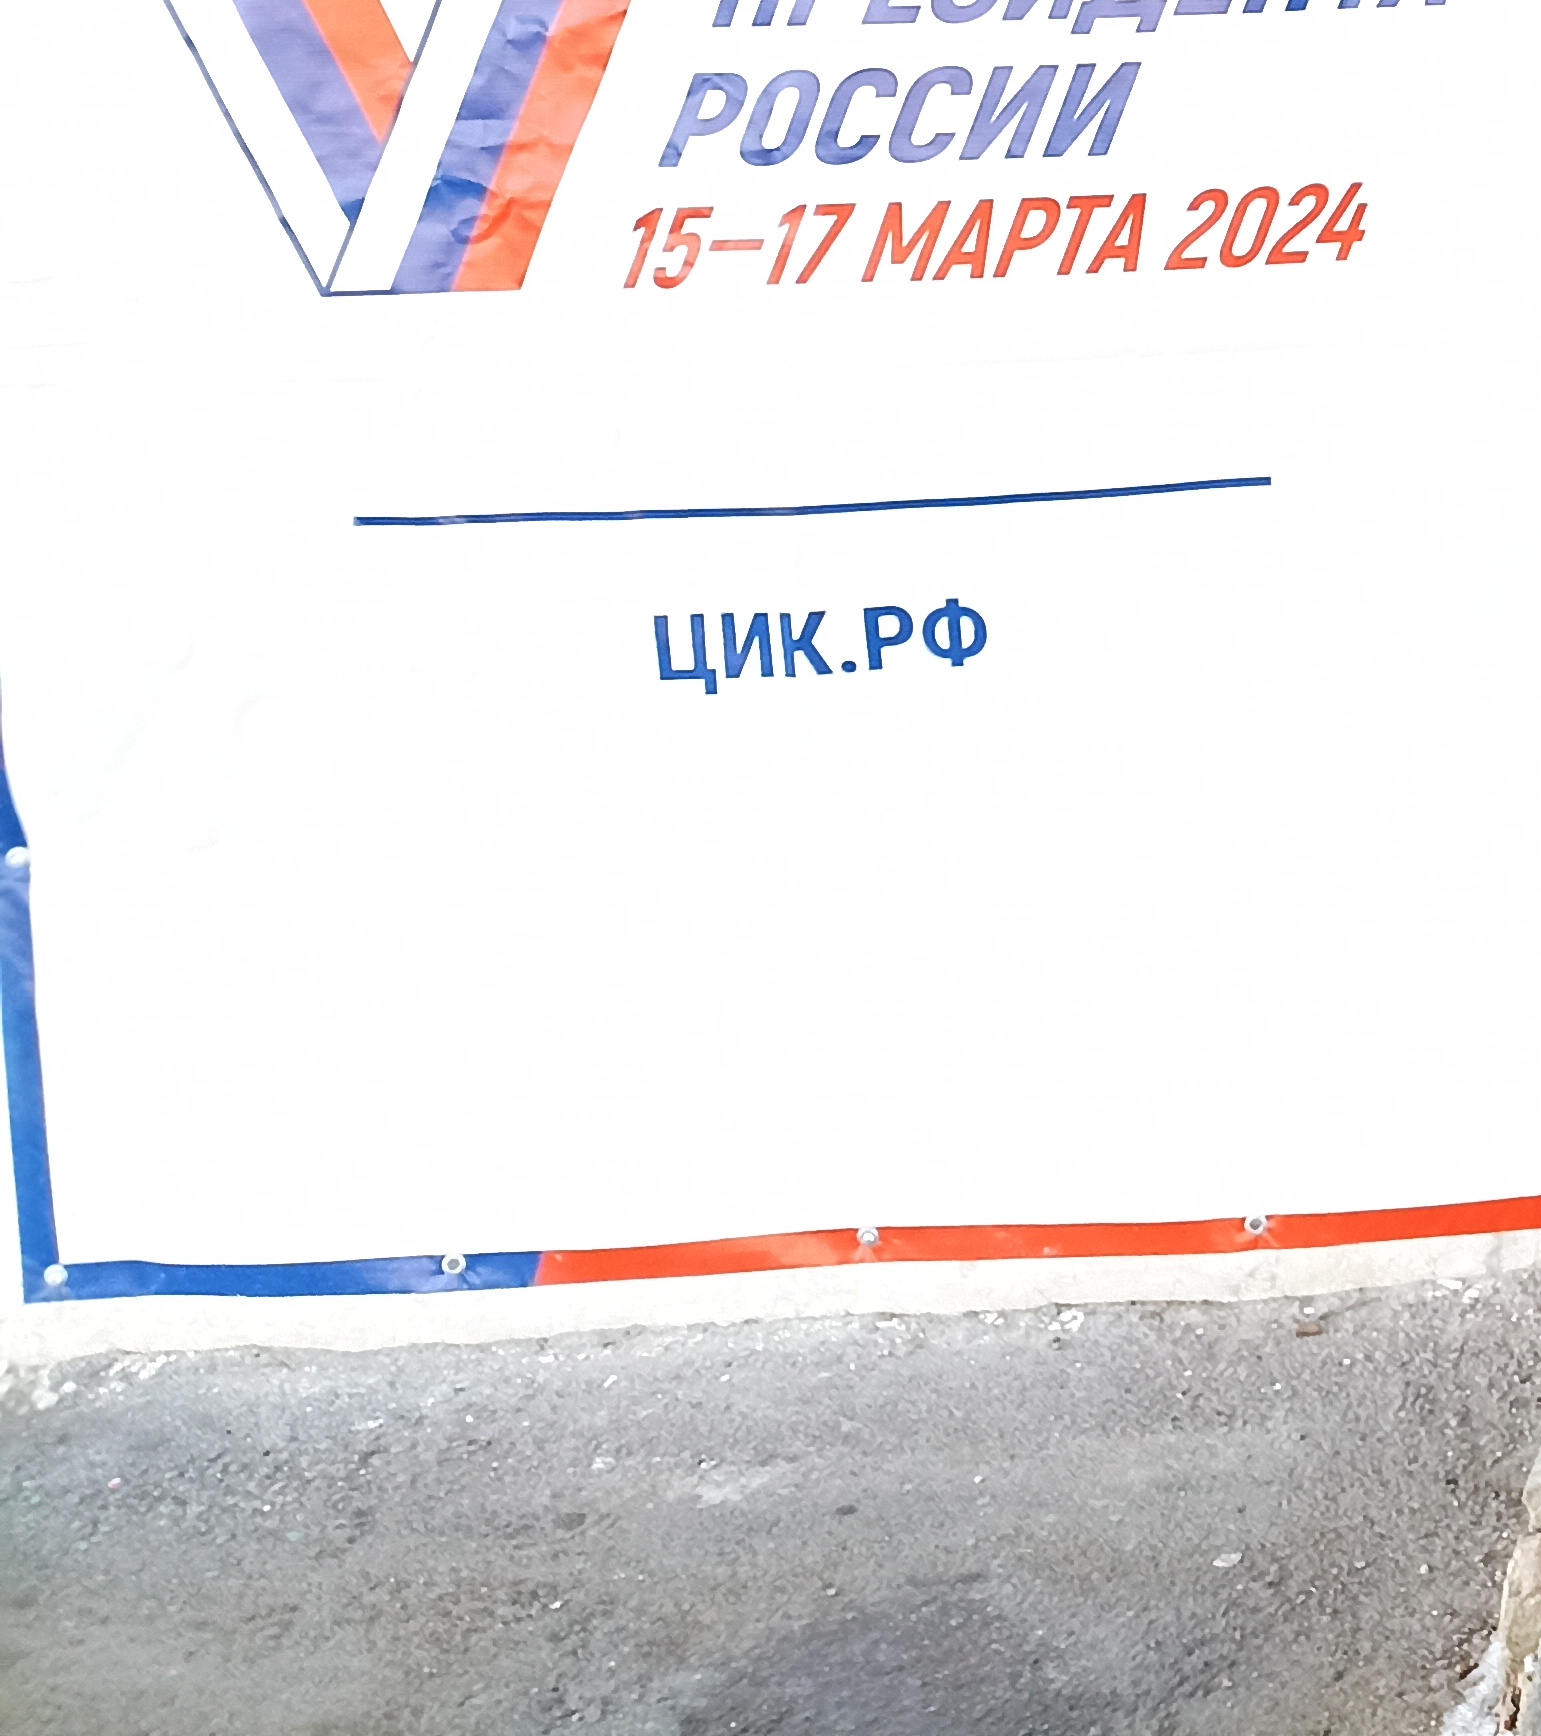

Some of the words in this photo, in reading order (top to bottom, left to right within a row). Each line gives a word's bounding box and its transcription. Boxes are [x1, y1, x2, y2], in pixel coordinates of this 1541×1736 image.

[658, 61, 1142, 170] РОССИИ
[862, 190, 1150, 287] МАРТА
[1164, 181, 1371, 272] 2024
[653, 598, 989, 697] ЦИК.РФ
